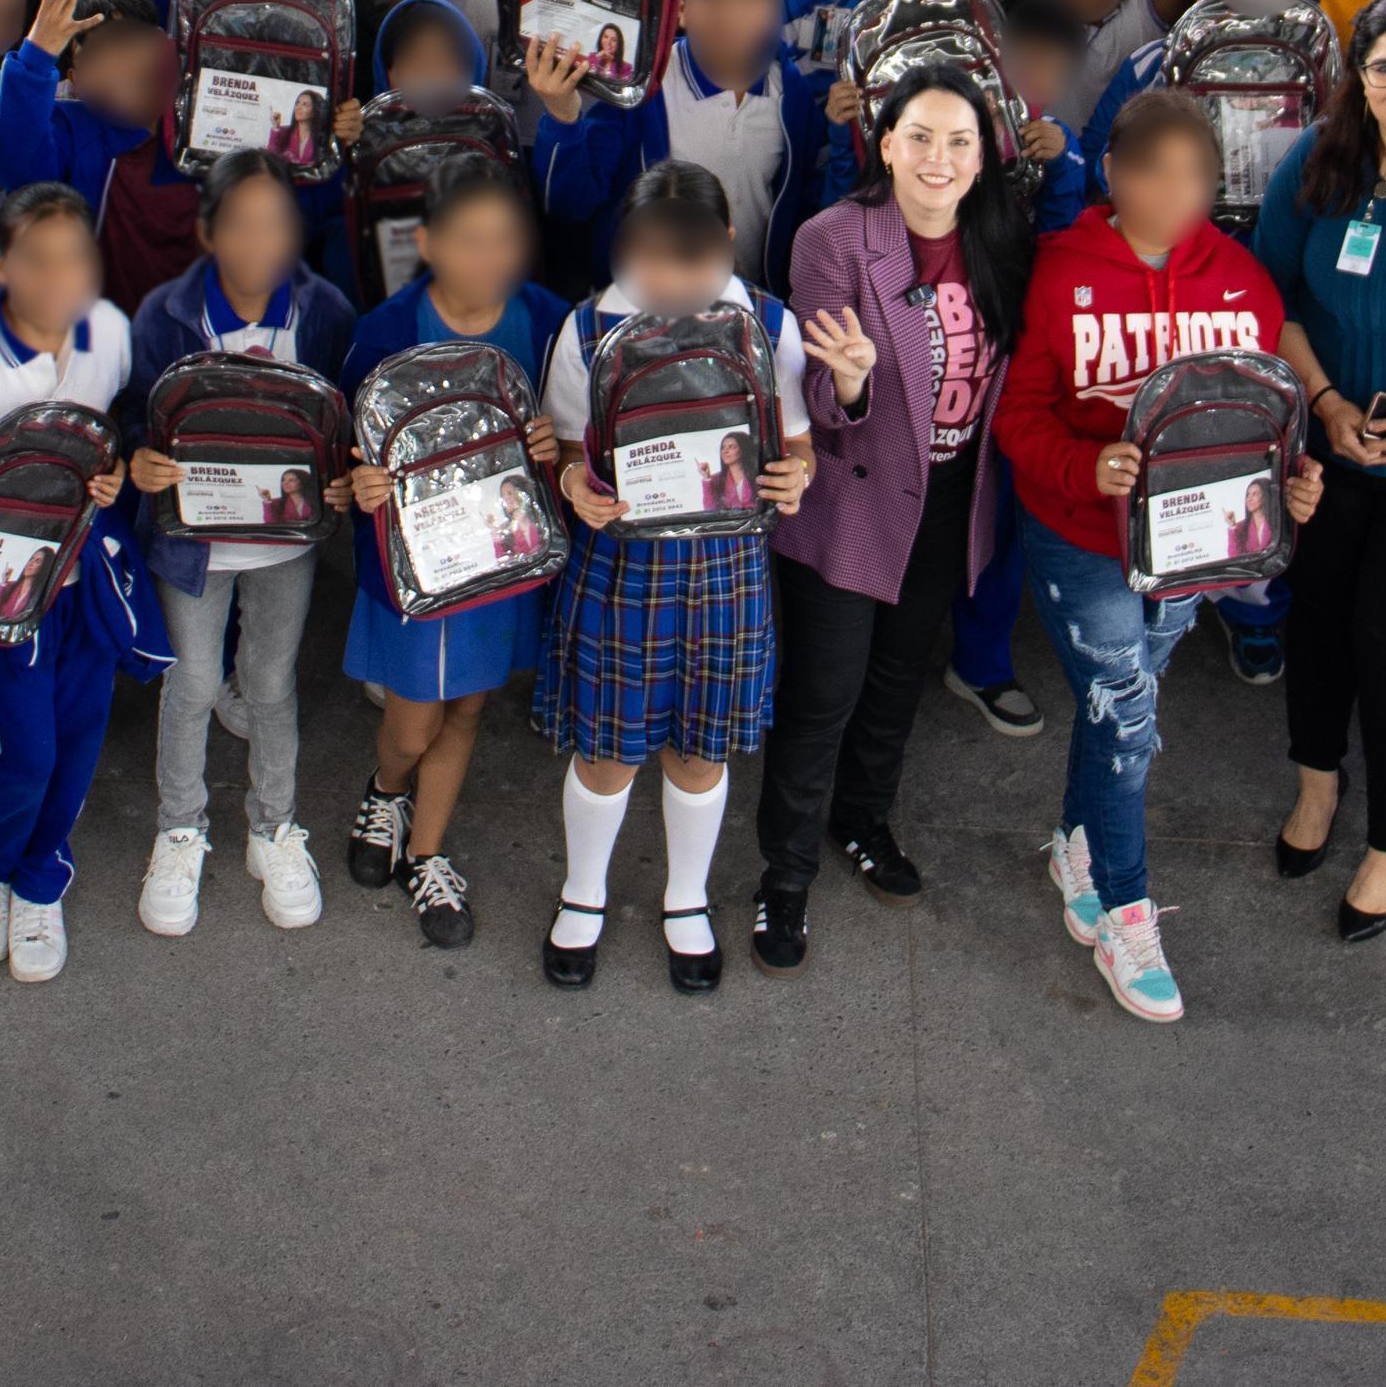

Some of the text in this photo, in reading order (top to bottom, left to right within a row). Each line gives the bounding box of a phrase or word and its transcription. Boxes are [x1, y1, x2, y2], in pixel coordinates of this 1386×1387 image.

[212, 76, 257, 91] BRENDA
[207, 87, 259, 101] VELÁZQUEZ
[1072, 311, 1261, 387] PATRIOTS
[629, 441, 676, 458] BRENDA
[626, 451, 681, 468] VELÁZQUEZ
[188, 476, 243, 484] VELÁZQUEZ
[191, 467, 237, 476] BRENDA
[1162, 492, 1205, 509] BRENDA
[1159, 502, 1210, 519] VELÁZQUEZ
